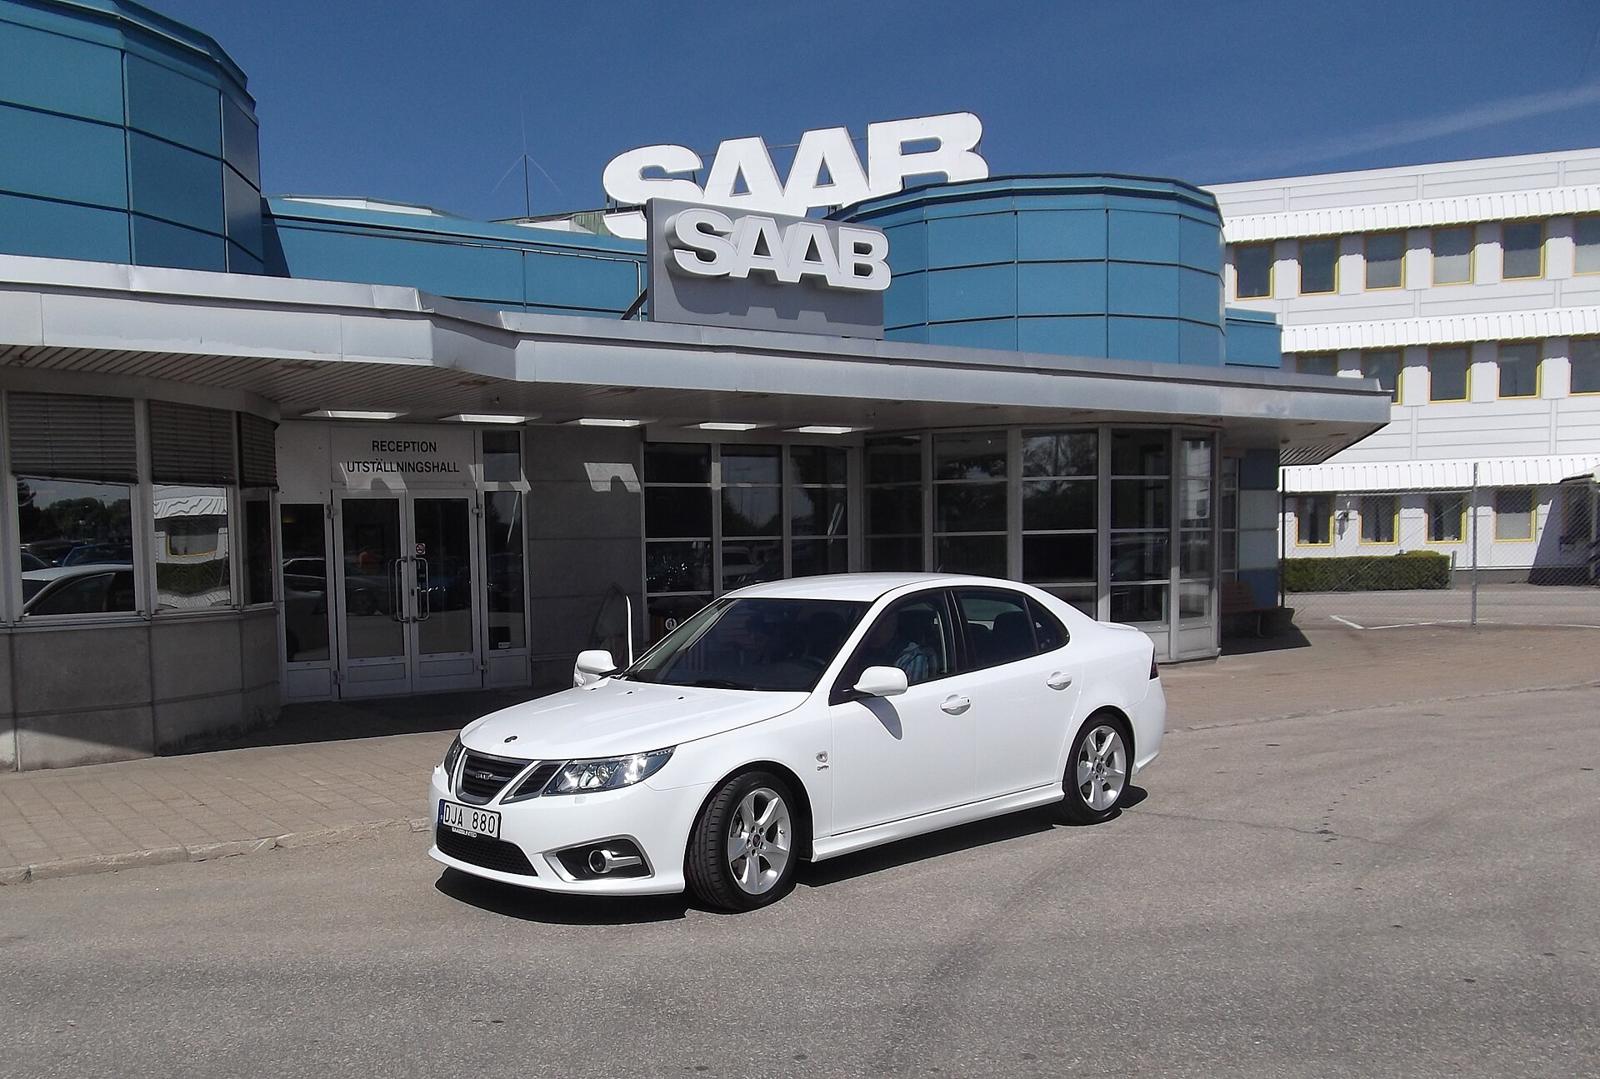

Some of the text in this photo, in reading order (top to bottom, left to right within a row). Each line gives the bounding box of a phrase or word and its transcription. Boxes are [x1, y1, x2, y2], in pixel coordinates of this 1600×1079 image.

[603, 111, 989, 239] SAAB
[671, 208, 892, 291] SAAB
[371, 440, 437, 453] RECEPTION
[346, 458, 460, 473] UTSTÄLLNINGSHALL
[444, 804, 463, 828] DJA
[471, 811, 496, 834] 880
